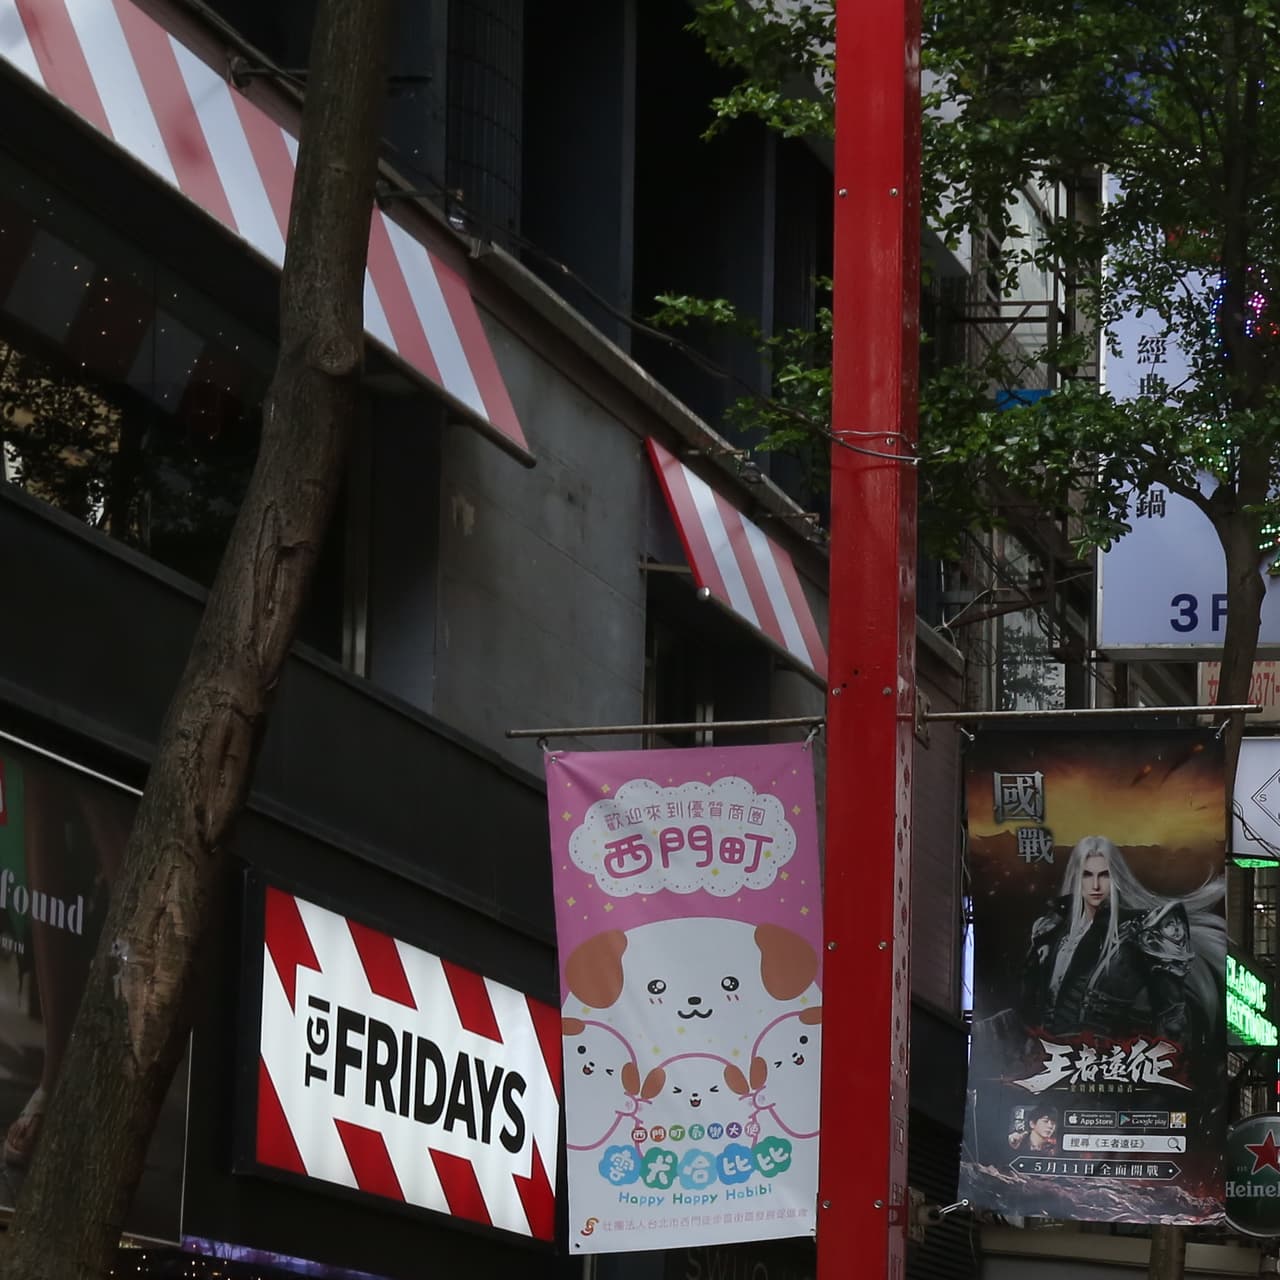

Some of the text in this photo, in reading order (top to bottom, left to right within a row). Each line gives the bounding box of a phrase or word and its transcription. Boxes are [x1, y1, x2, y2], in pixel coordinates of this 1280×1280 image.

[603, 799, 766, 832] 歡迎來到優質商圈
[993, 771, 1054, 864] 國戰
[603, 824, 774, 879] 西門町
[304, 995, 527, 1154] TGI FRIDAYS
[1013, 1037, 1193, 1095] 王者遠征
[1095, 1118, 1114, 1126] Store
[1034, 1161, 1159, 1178] 5月11日全面開戰
[618, 1183, 773, 1207] Happy Happy Habibi
